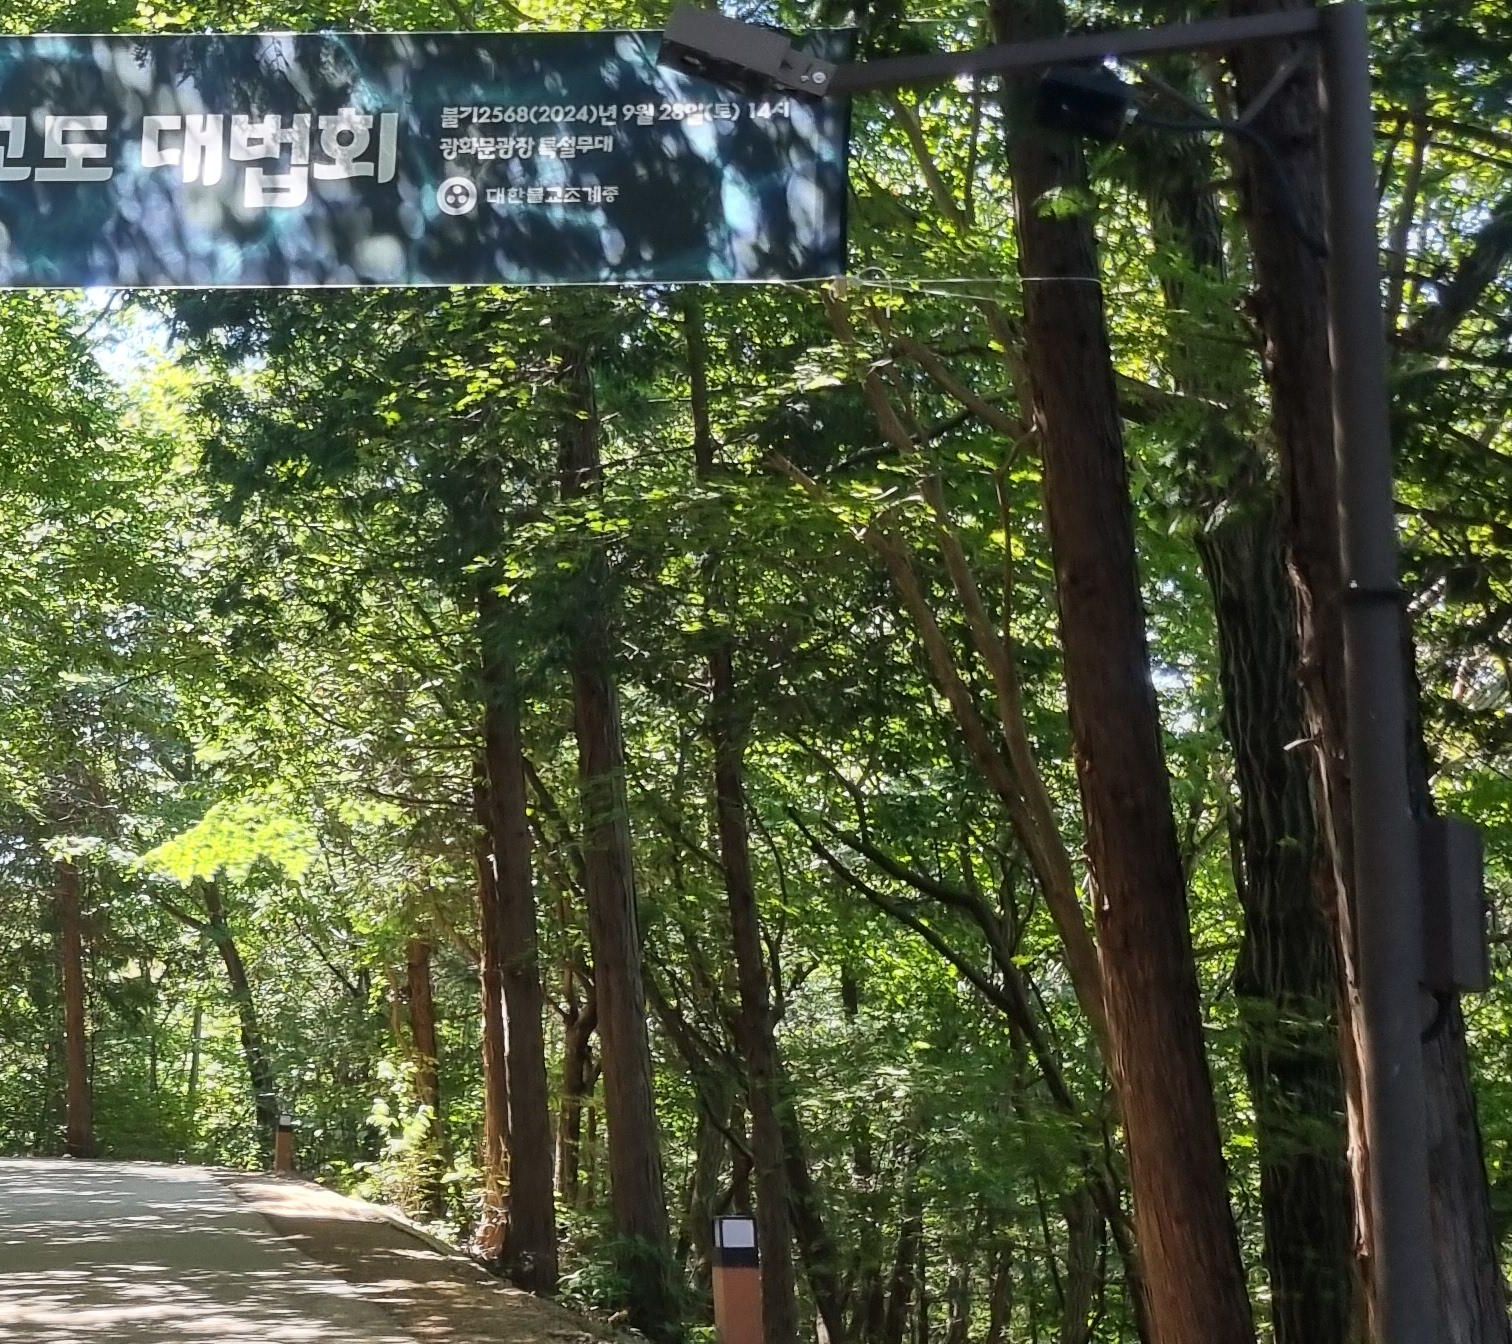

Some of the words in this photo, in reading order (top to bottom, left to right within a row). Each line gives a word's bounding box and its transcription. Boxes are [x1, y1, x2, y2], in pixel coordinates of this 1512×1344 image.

[440, 104, 617, 128] 불기2568(2024)년
[622, 103, 655, 126] 9월
[659, 102, 741, 127] 28일(토)
[749, 101, 790, 119] 14시
[141, 107, 399, 208] 대법회
[440, 136, 535, 160] 광화문광장
[539, 135, 614, 159] 특설무대
[485, 185, 619, 204] 대한불교조계종
